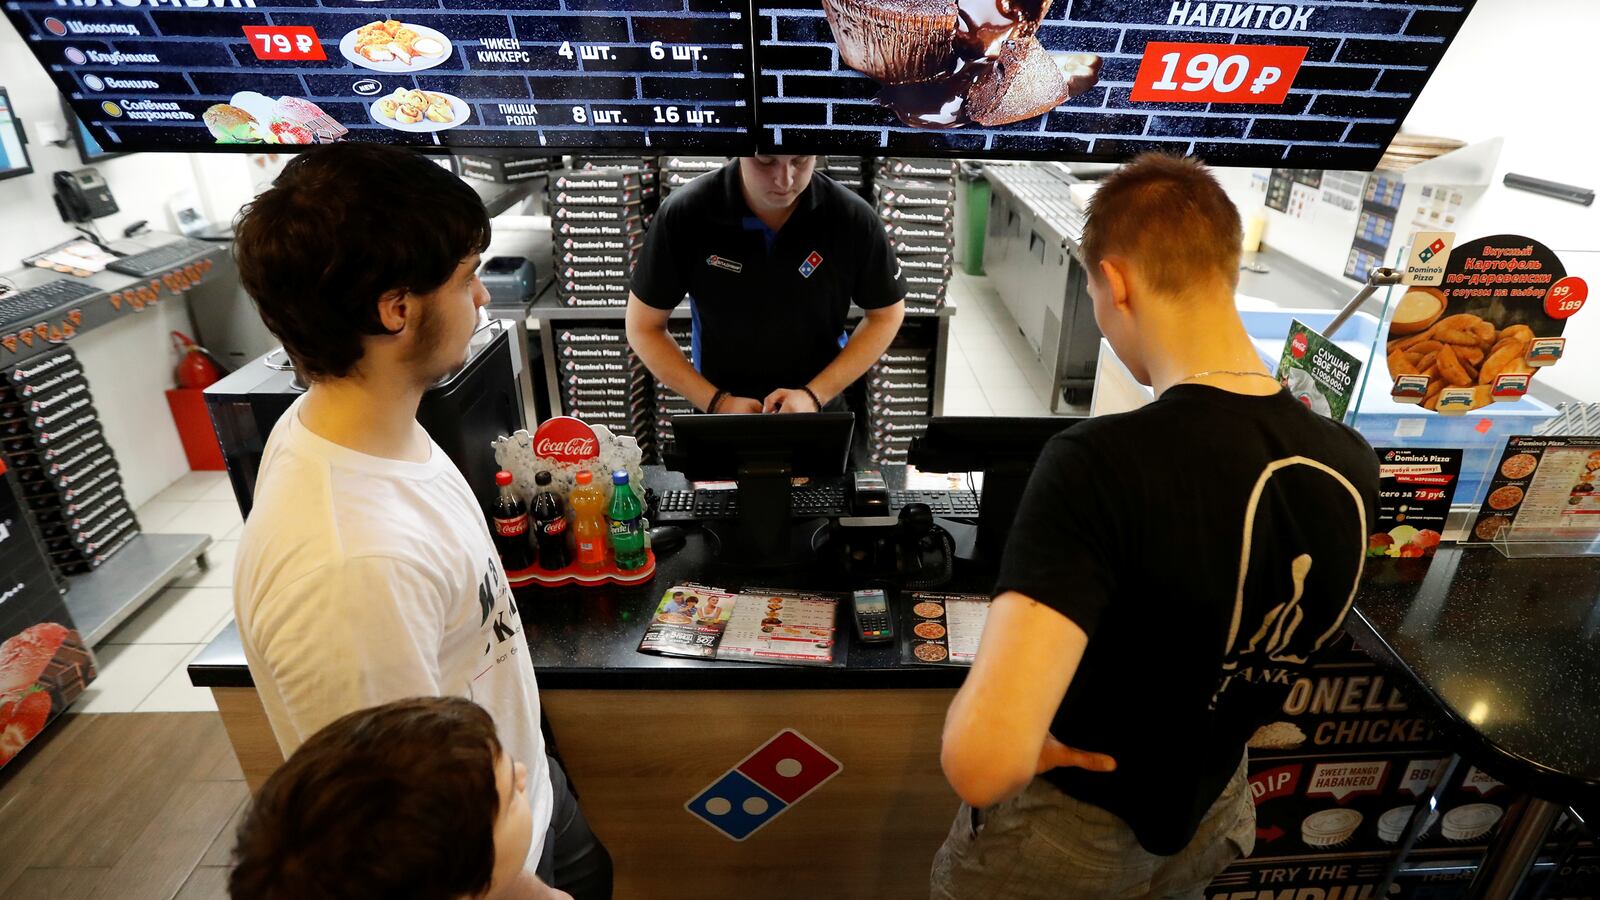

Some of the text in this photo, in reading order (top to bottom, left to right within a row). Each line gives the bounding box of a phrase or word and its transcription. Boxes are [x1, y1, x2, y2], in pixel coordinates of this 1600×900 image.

[1166, 2, 1315, 31] НАПИТОК
[66, 20, 140, 36] Шоколад
[255, 33, 314, 53] 79 ₽
[479, 37, 520, 51] ЧИКЕН
[85, 49, 160, 66] Клубника
[477, 50, 530, 63] КИККЕРС
[558, 41, 617, 61] 4 шт.
[650, 41, 708, 61] 6 шт.
[1150, 51, 1282, 94] 190 ₽
[105, 76, 159, 91] Ваниль
[120, 99, 180, 111] Солёная
[498, 103, 538, 116] ПИЦЦА
[127, 109, 196, 123] карамель
[506, 114, 536, 126] РОЛЛ
[572, 106, 628, 124] 8 шт.
[653, 106, 721, 124] 16 шт.
[598, 179, 618, 188] Pizza
[597, 195, 618, 204] Pizza
[598, 211, 618, 219] Pizza
[601, 226, 621, 234] Pizza
[604, 241, 624, 249] Pizza
[1482, 245, 1534, 257] Вкусный
[603, 255, 623, 263] Pizza
[1464, 257, 1542, 271] Картофель
[605, 269, 625, 277] Pizza
[1408, 265, 1442, 274] Domino's
[1412, 274, 1433, 282] Pizza
[1446, 273, 1552, 285] по-деревенски
[1443, 285, 1546, 299] с соусом на выбор
[1552, 286, 1570, 296] 99
[607, 298, 627, 306] Pizza
[1558, 300, 1583, 311] 189
[602, 349, 621, 357] Pizza
[1318, 347, 1350, 374] СЛУШАЙ
[1312, 354, 1332, 373] СВОЕ
[1331, 366, 1351, 386] ЛЕТО
[536, 436, 595, 456] Coca-Cola
[1430, 455, 1450, 463] Pizza
[1415, 490, 1427, 498] 79
[1428, 490, 1446, 500] руб.
[1319, 766, 1379, 777] SWEET MANGO
[1249, 771, 1292, 798] DIP
[1315, 775, 1376, 788] HABANERO
[1258, 865, 1352, 884] TRY THE
